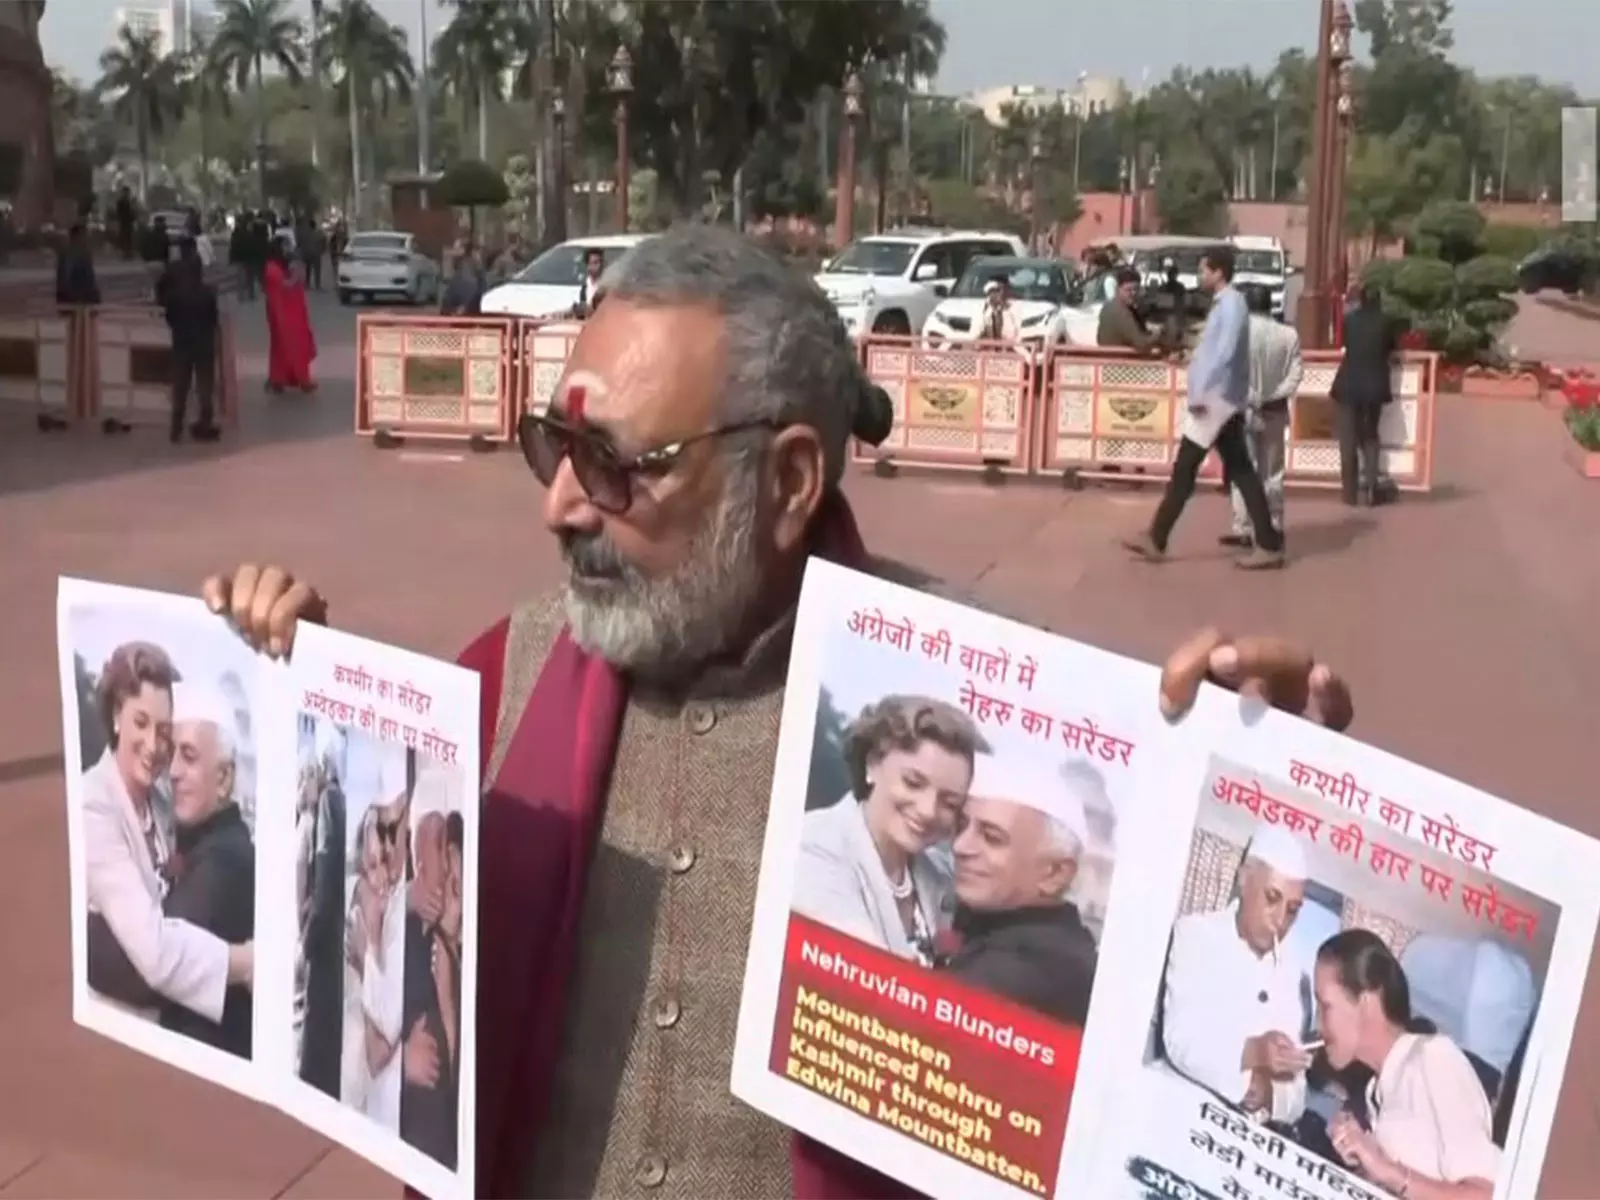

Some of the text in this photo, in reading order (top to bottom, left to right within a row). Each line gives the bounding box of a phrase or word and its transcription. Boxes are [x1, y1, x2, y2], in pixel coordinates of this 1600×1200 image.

[377, 678, 394, 703] का
[847, 608, 916, 652] अंग्रेजों
[920, 629, 952, 665] की
[1017, 655, 1039, 691] में
[379, 717, 399, 743] हार
[1020, 706, 1054, 740] का
[1060, 717, 1136, 767] सरेंडर
[1289, 758, 1498, 873] कश्मीर का सरेंडर
[1328, 822, 1365, 860] की
[1369, 840, 1415, 883] हार
[1420, 862, 1455, 902] पर
[1460, 882, 1541, 942] सरेंडर
[796, 984, 951, 1071] Mountbatten
[801, 940, 1057, 1066] Nehruvian Blunders
[786, 1056, 1047, 1193] Edwina Mountbatten.
[789, 1033, 992, 1143] Kashmir through
[925, 1070, 1003, 1120] Nehru
[1008, 1111, 1043, 1137] on
[1200, 1102, 1287, 1159] विदेशी
